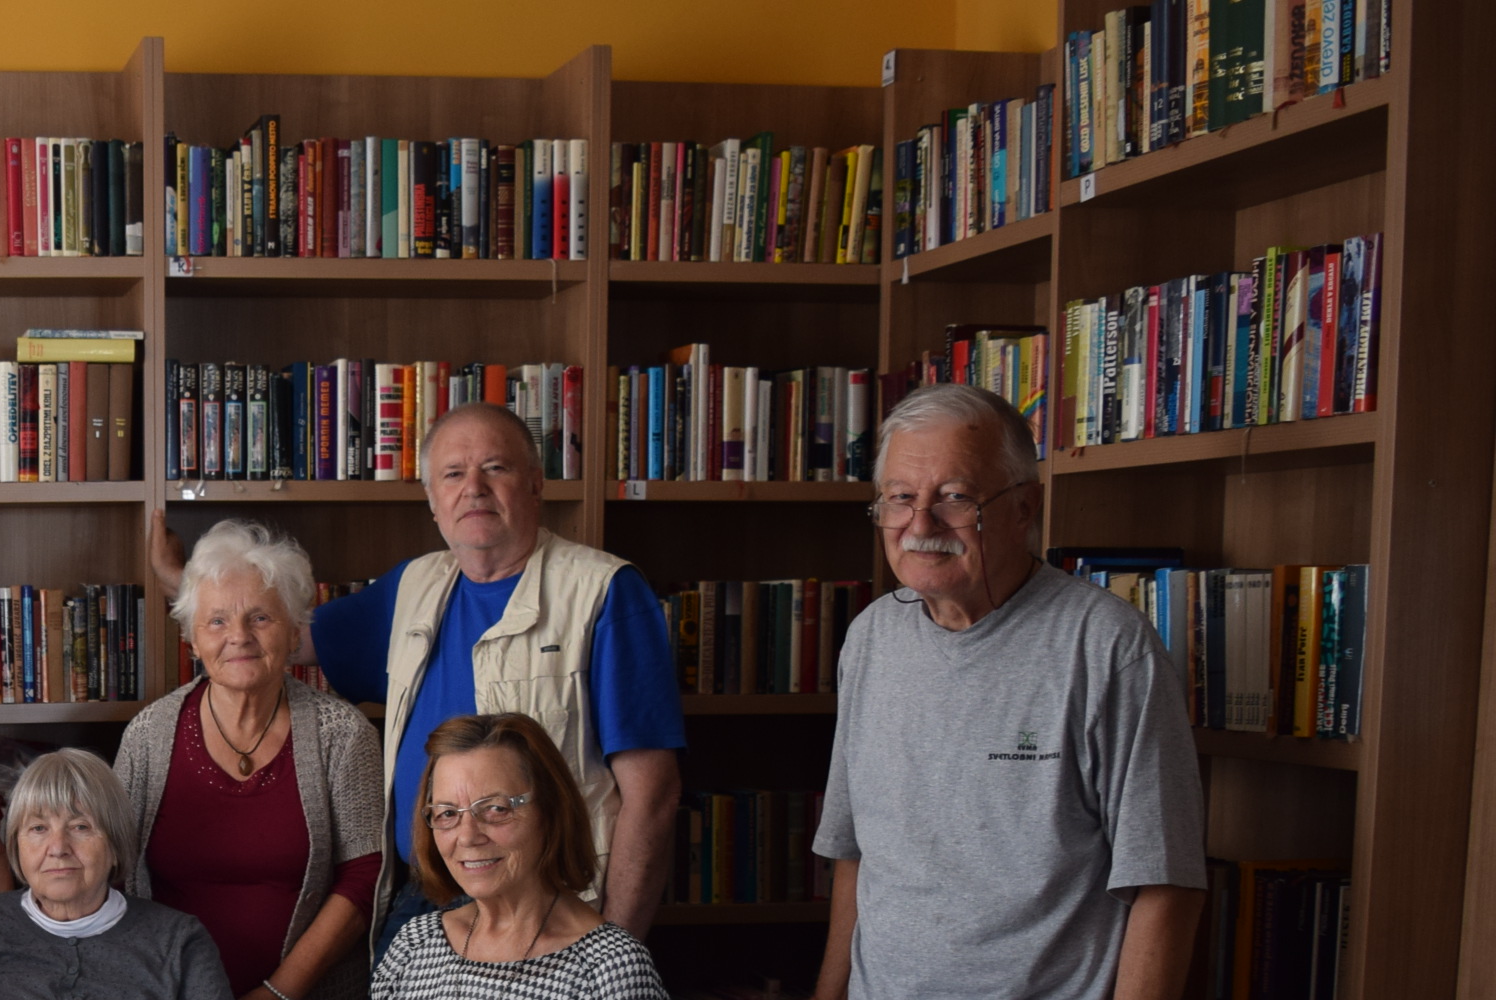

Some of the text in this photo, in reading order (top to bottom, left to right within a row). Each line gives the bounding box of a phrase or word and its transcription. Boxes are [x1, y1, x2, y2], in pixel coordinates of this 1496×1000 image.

[1319, 27, 1335, 78] drevo
[994, 104, 1002, 131] BRITVE
[1079, 56, 1089, 153] GOZD OBEŠENIH LISIC
[1103, 311, 1119, 387] Patterson
[7, 372, 18, 444] OPREDELITEV
[41, 389, 51, 409] KRILI
[41, 410, 52, 451] RAZPRTIMI
[319, 380, 330, 460] UPORNIK MEMED
[42, 459, 53, 477] OREL
[633, 484, 640, 495] L
[1296, 656, 1306, 683] Ivan
[987, 753, 1037, 761] SVETLOBNI
